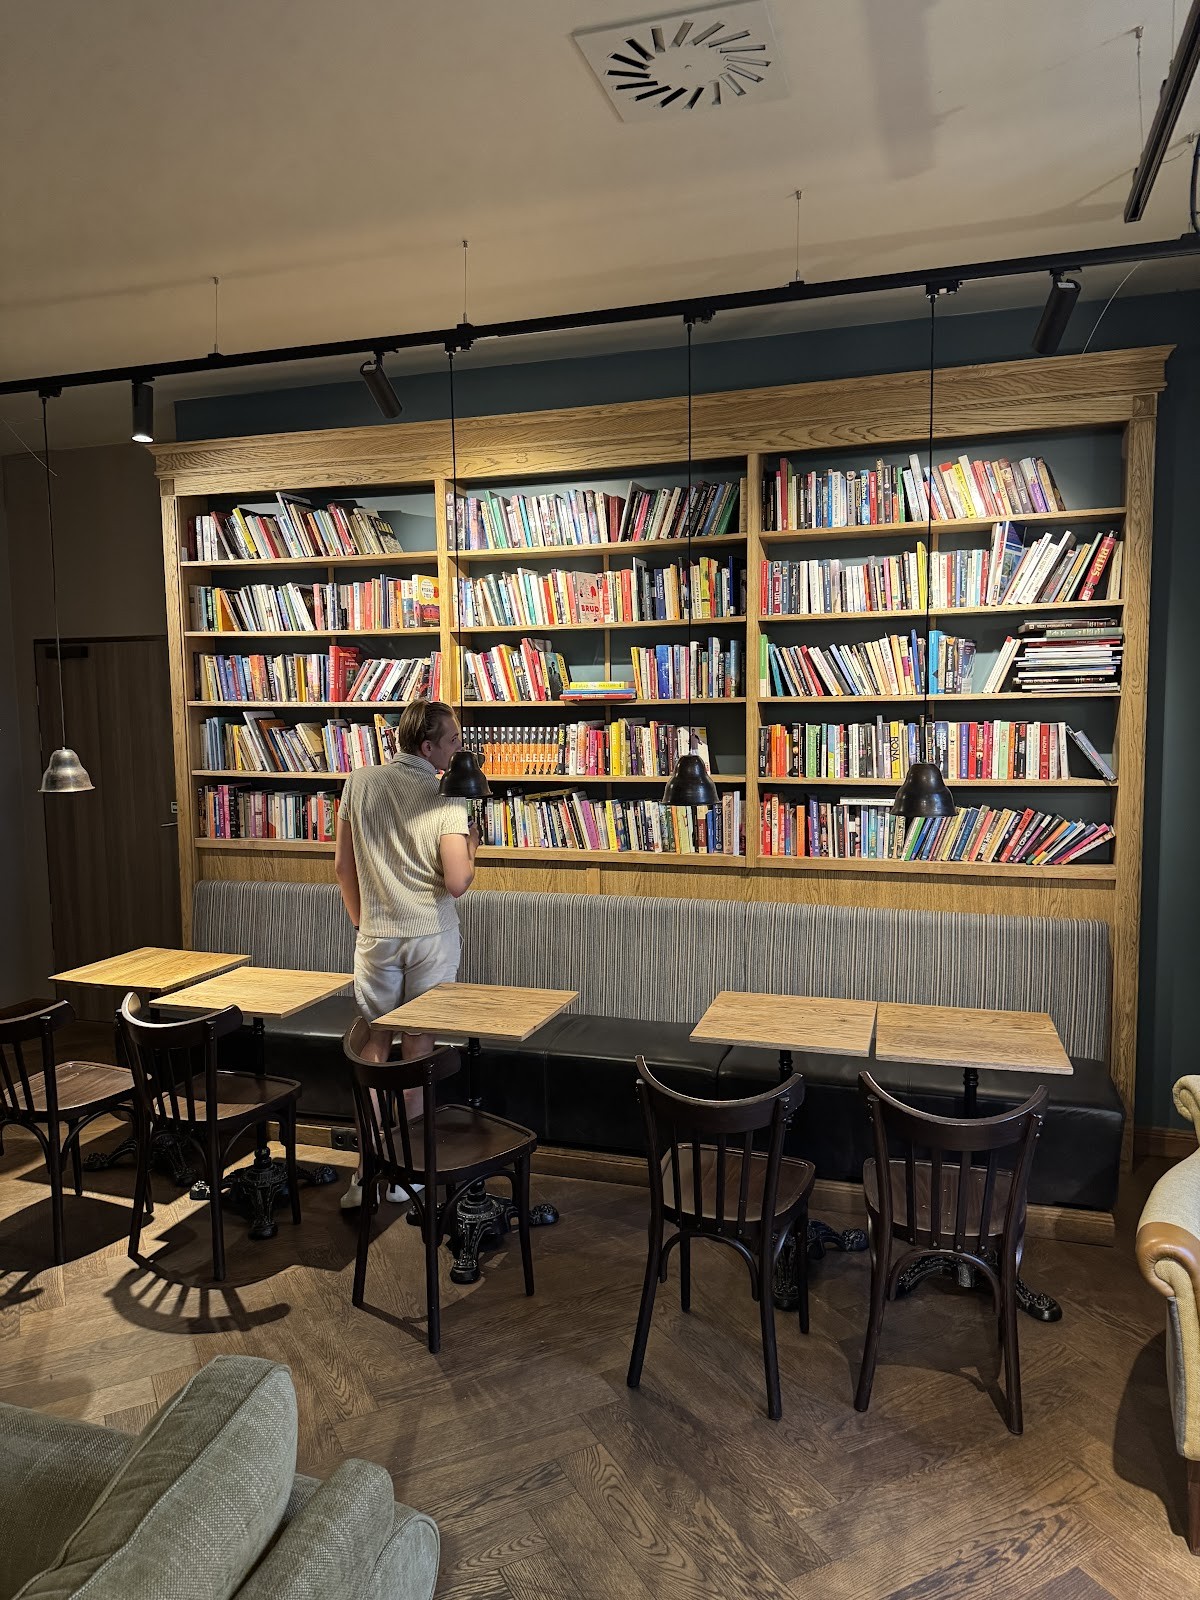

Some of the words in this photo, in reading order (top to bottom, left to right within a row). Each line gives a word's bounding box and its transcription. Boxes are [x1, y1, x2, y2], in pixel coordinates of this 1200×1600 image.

[1090, 547, 1110, 577] PHP5
[581, 604, 599, 613] BRUD
[891, 736, 900, 763] RONA
